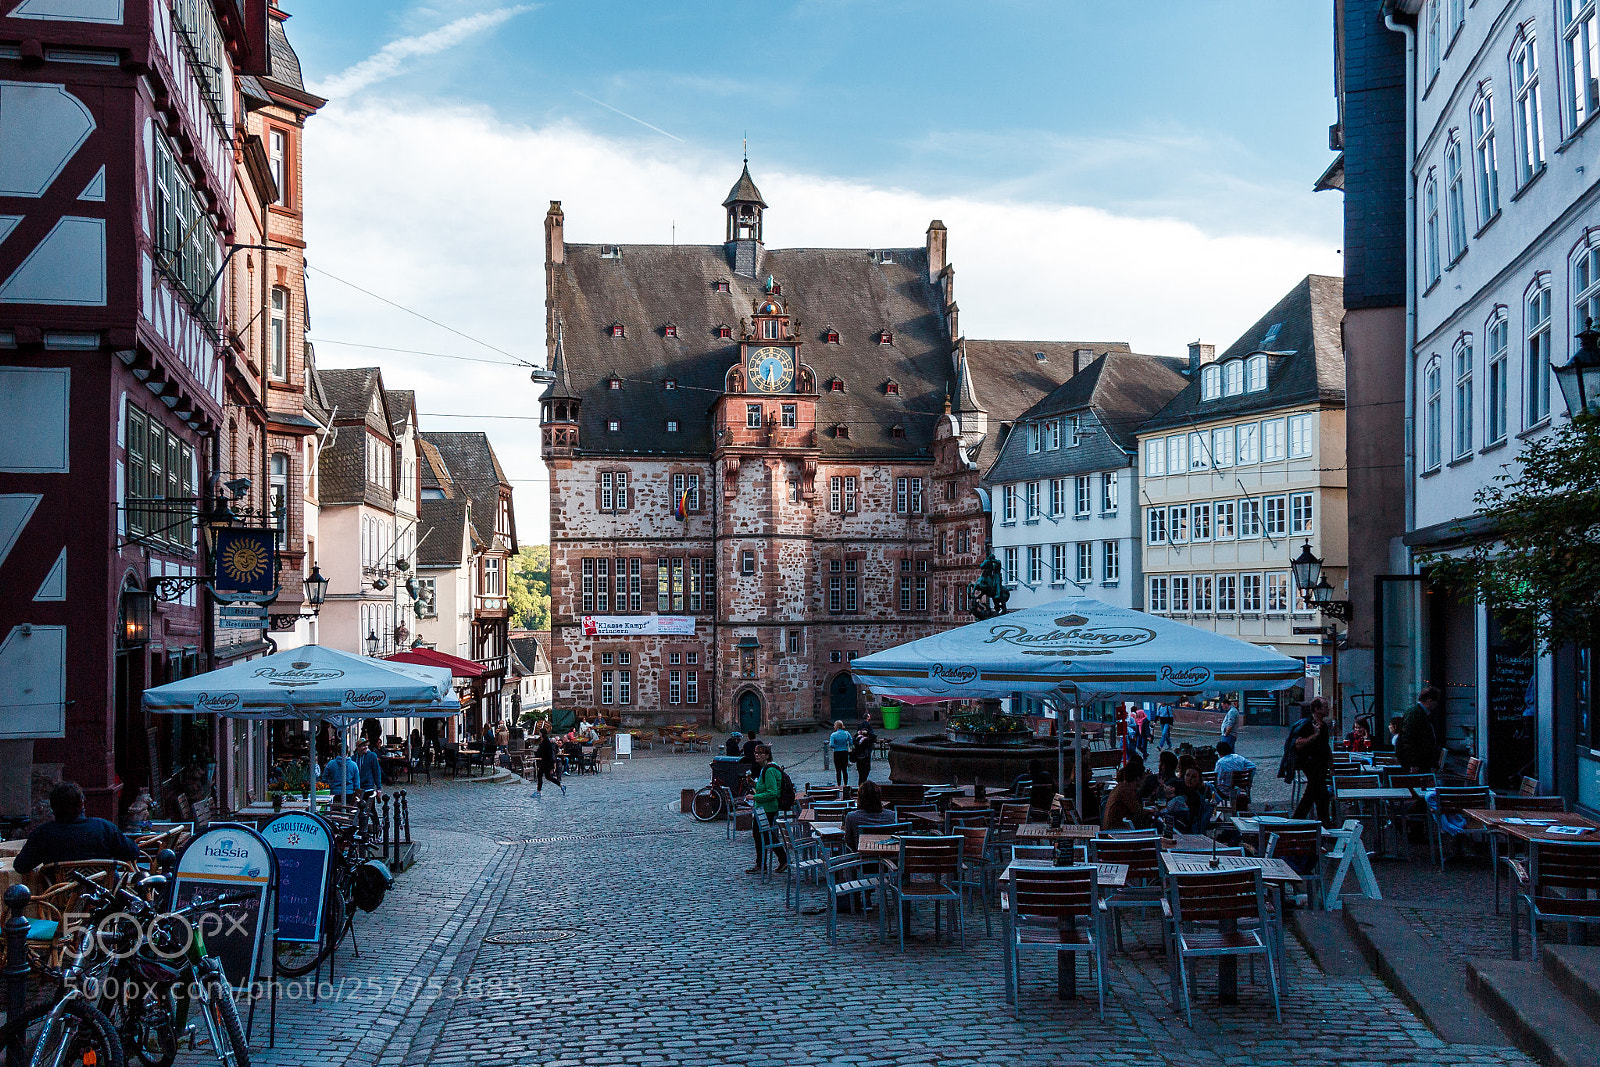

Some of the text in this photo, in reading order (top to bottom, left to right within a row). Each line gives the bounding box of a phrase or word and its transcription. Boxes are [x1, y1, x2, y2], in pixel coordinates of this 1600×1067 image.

[984, 624, 1157, 646] Radeberger
[250, 667, 344, 679] Radeberger
[932, 663, 977, 681] Radeberger
[1160, 665, 1210, 682] Radeberger
[197, 692, 239, 708] Radeberger
[344, 689, 386, 704] Radeberger
[272, 821, 319, 836] GEROLSTEINER
[204, 845, 249, 859] hassia
